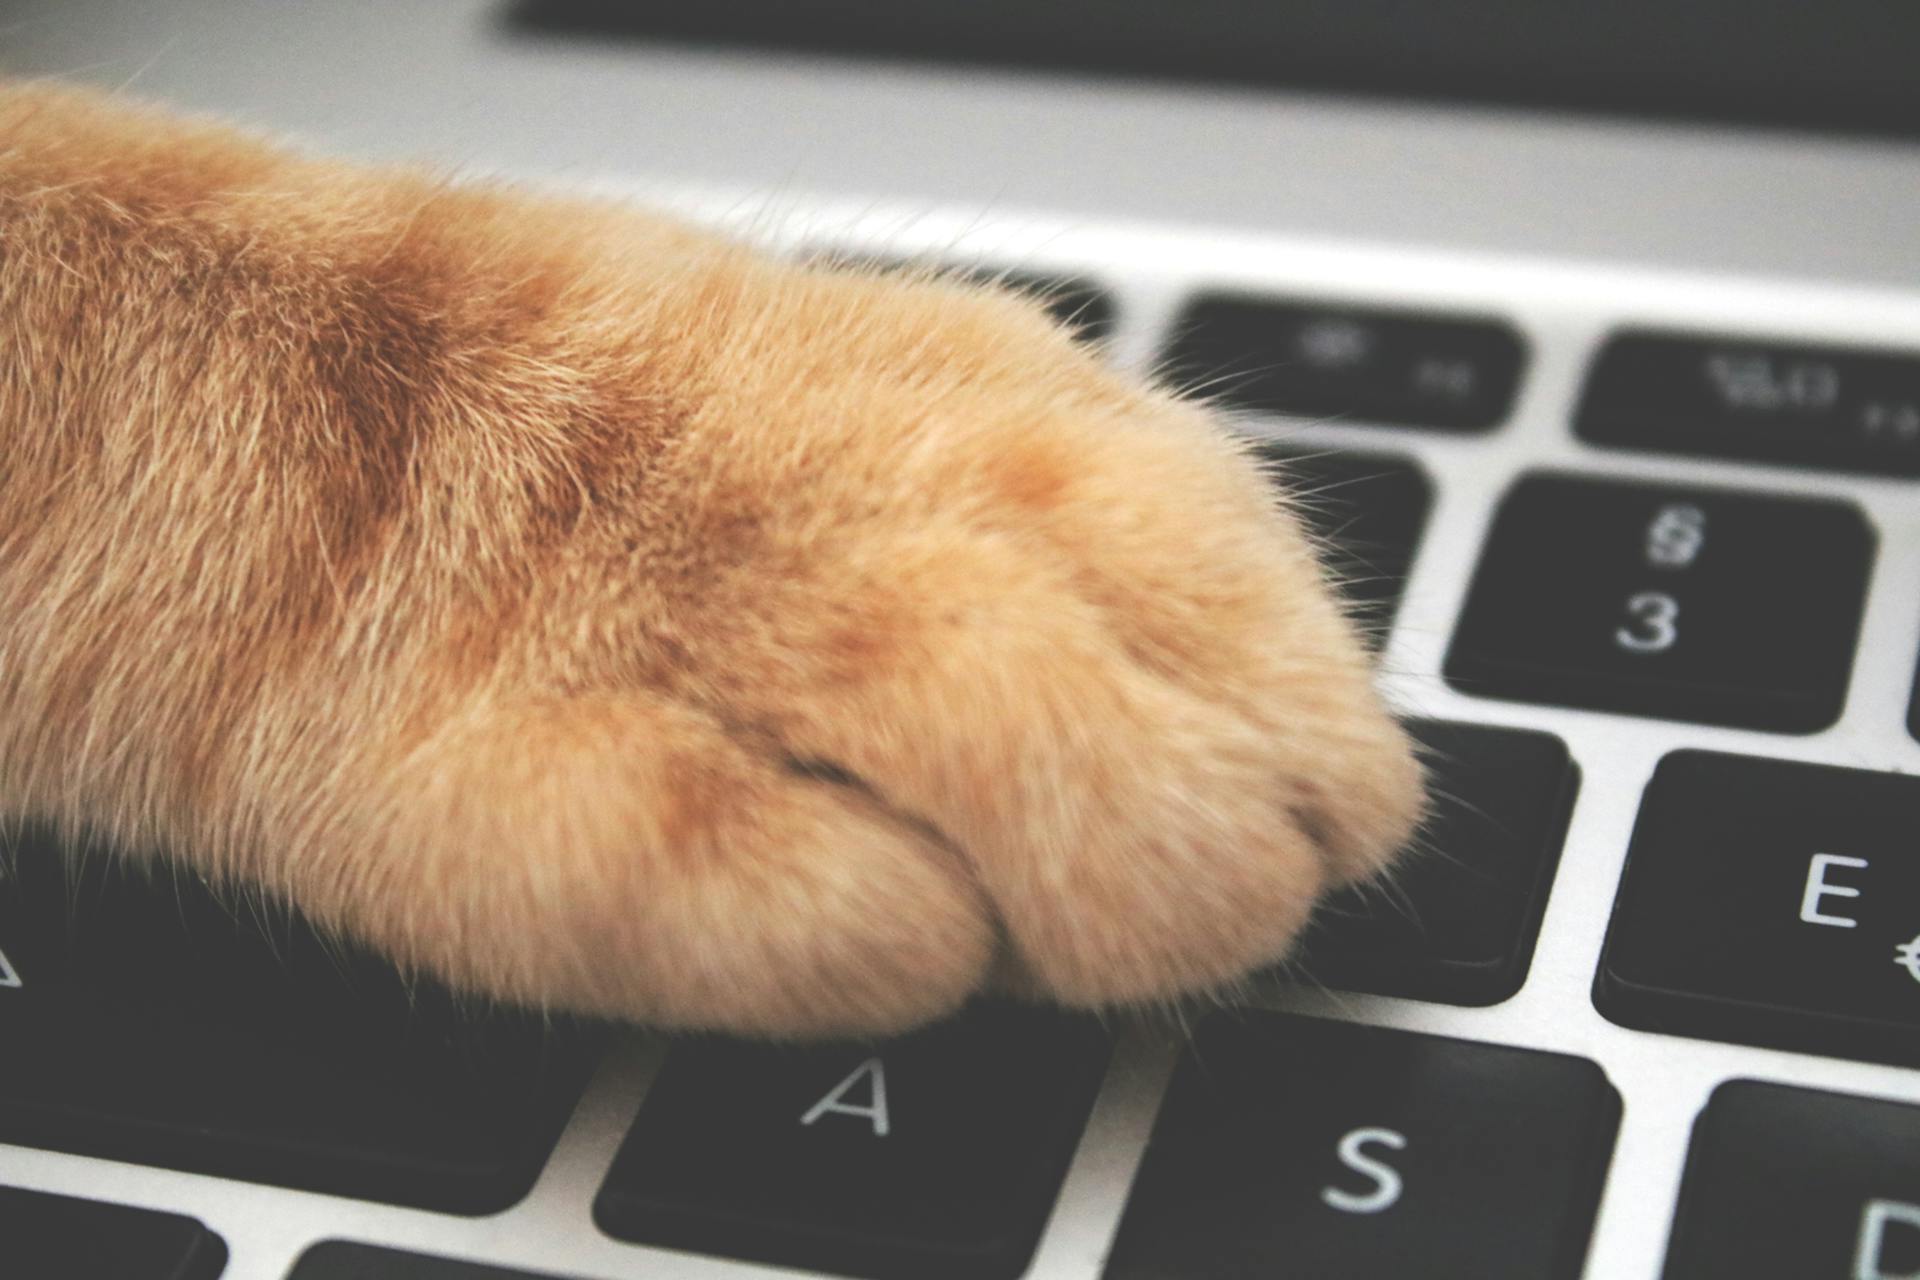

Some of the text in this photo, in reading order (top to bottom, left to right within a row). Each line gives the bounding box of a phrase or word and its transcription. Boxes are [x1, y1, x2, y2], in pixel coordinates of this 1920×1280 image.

[1614, 591, 1679, 652] 3
[1799, 852, 1868, 927] E
[800, 1058, 889, 1135] A
[1321, 1126, 1406, 1213] S
